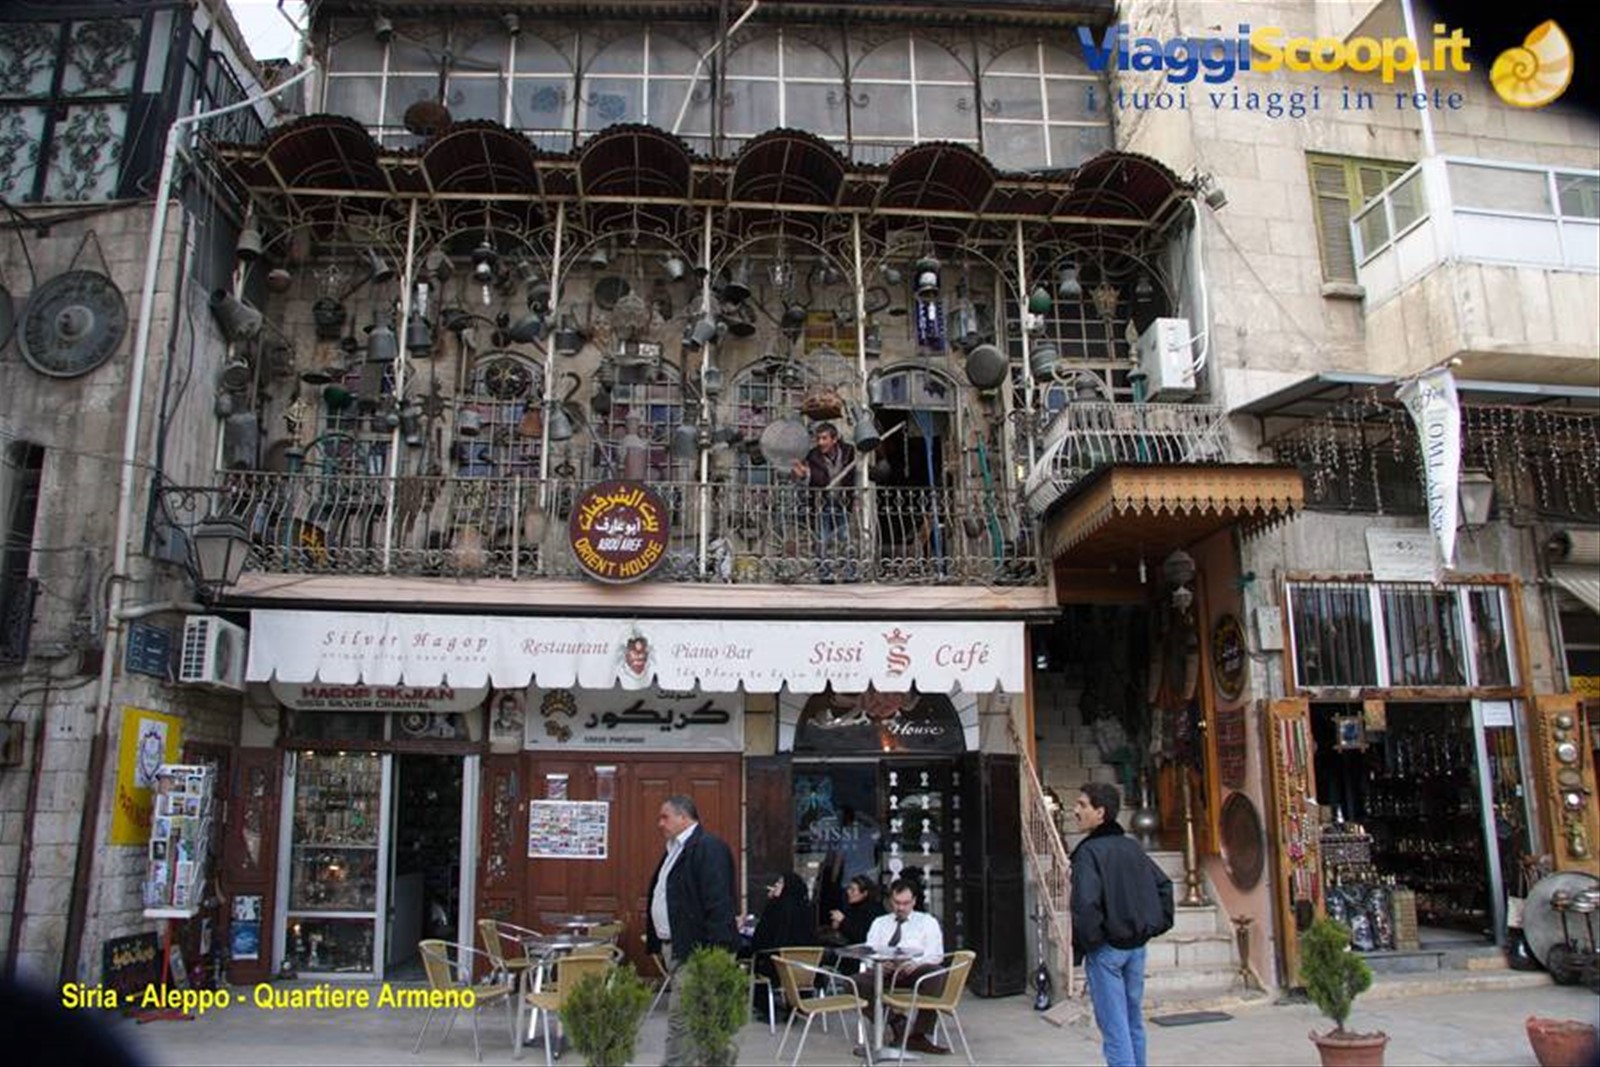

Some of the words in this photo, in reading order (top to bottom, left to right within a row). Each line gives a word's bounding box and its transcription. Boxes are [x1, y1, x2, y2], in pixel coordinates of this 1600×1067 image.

[575, 538, 617, 575] ORIENT
[620, 540, 663, 577] HOUSE
[323, 630, 398, 647] Silver
[412, 631, 488, 652] Hagop
[520, 638, 609, 656] Restaurant
[671, 643, 719, 659] Piano
[722, 643, 754, 659] Bar
[809, 640, 865, 665] Sissi
[935, 641, 991, 671] Café
[302, 685, 371, 699] HAGOP
[584, 699, 731, 732] كريكور
